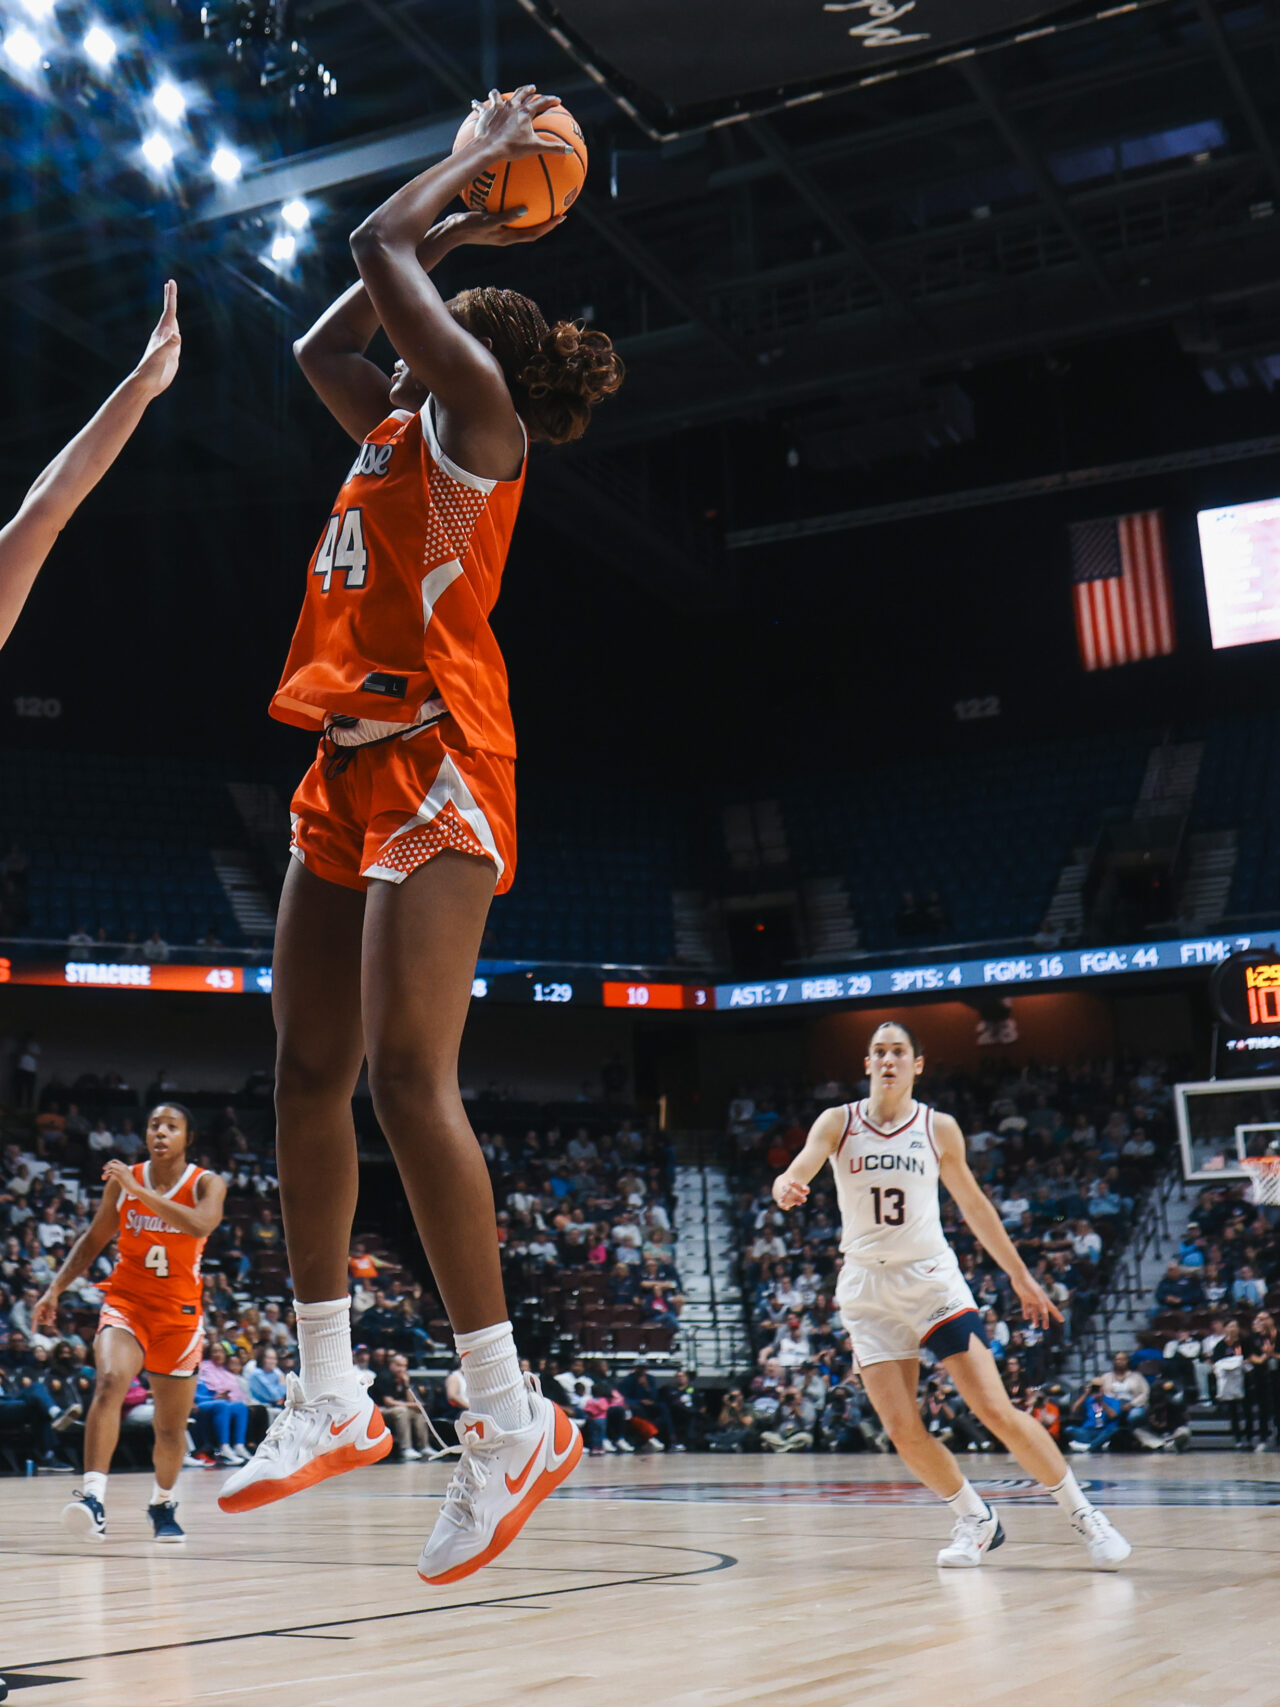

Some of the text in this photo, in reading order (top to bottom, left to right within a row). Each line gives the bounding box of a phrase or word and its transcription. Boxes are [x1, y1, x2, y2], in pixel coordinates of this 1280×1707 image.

[312, 506, 370, 594] 44
[65, 962, 151, 986] SYRACUSE
[205, 969, 234, 988] 43
[730, 984, 772, 1007] AST:
[775, 983, 789, 1002] 7
[801, 980, 844, 1000] REB:
[848, 975, 871, 995] 29
[891, 969, 944, 992] 3PTS:
[947, 966, 962, 985] 4
[983, 960, 1033, 982] FGM:
[1039, 956, 1064, 977] 16
[1080, 951, 1128, 974] FGA:
[1132, 947, 1159, 968] 44
[1180, 940, 1232, 964] FTM:
[533, 983, 572, 1002] 1:29
[626, 987, 649, 1005] 10
[695, 990, 705, 1004] 3
[1247, 987, 1280, 1025] 10
[850, 1154, 925, 1175] UCONN
[870, 1186, 905, 1226] 13
[144, 1245, 169, 1277] 4
